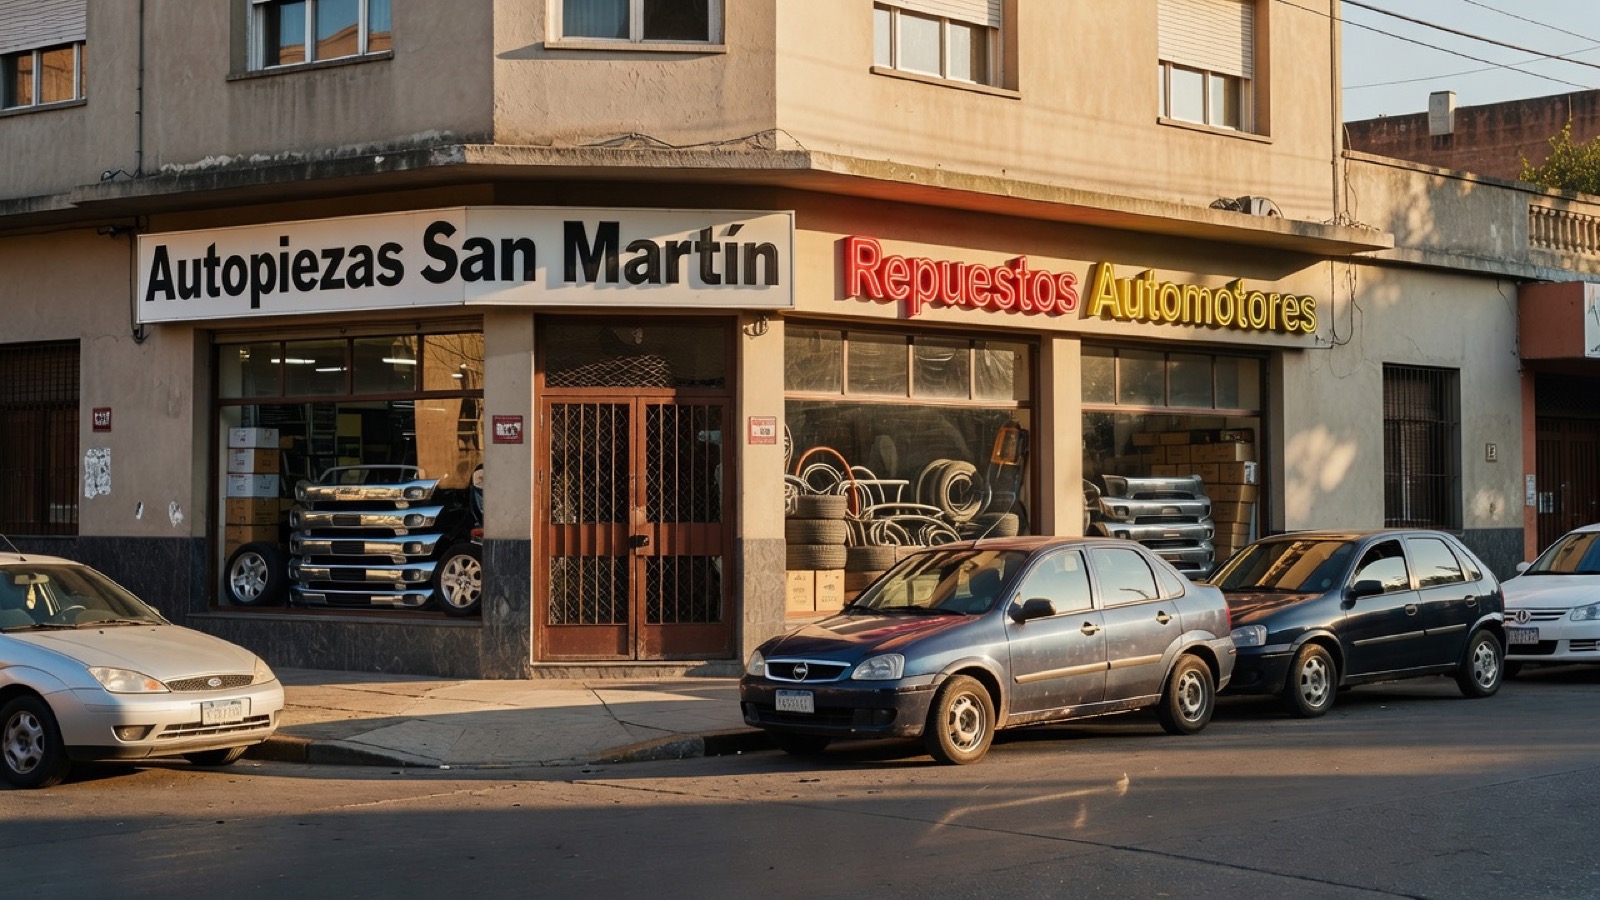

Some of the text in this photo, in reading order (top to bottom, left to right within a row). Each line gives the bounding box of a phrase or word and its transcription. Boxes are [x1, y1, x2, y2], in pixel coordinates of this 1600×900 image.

[145, 220, 780, 309] Autopiezas San Martín
[846, 236, 1318, 335] Repuestos Automotores
